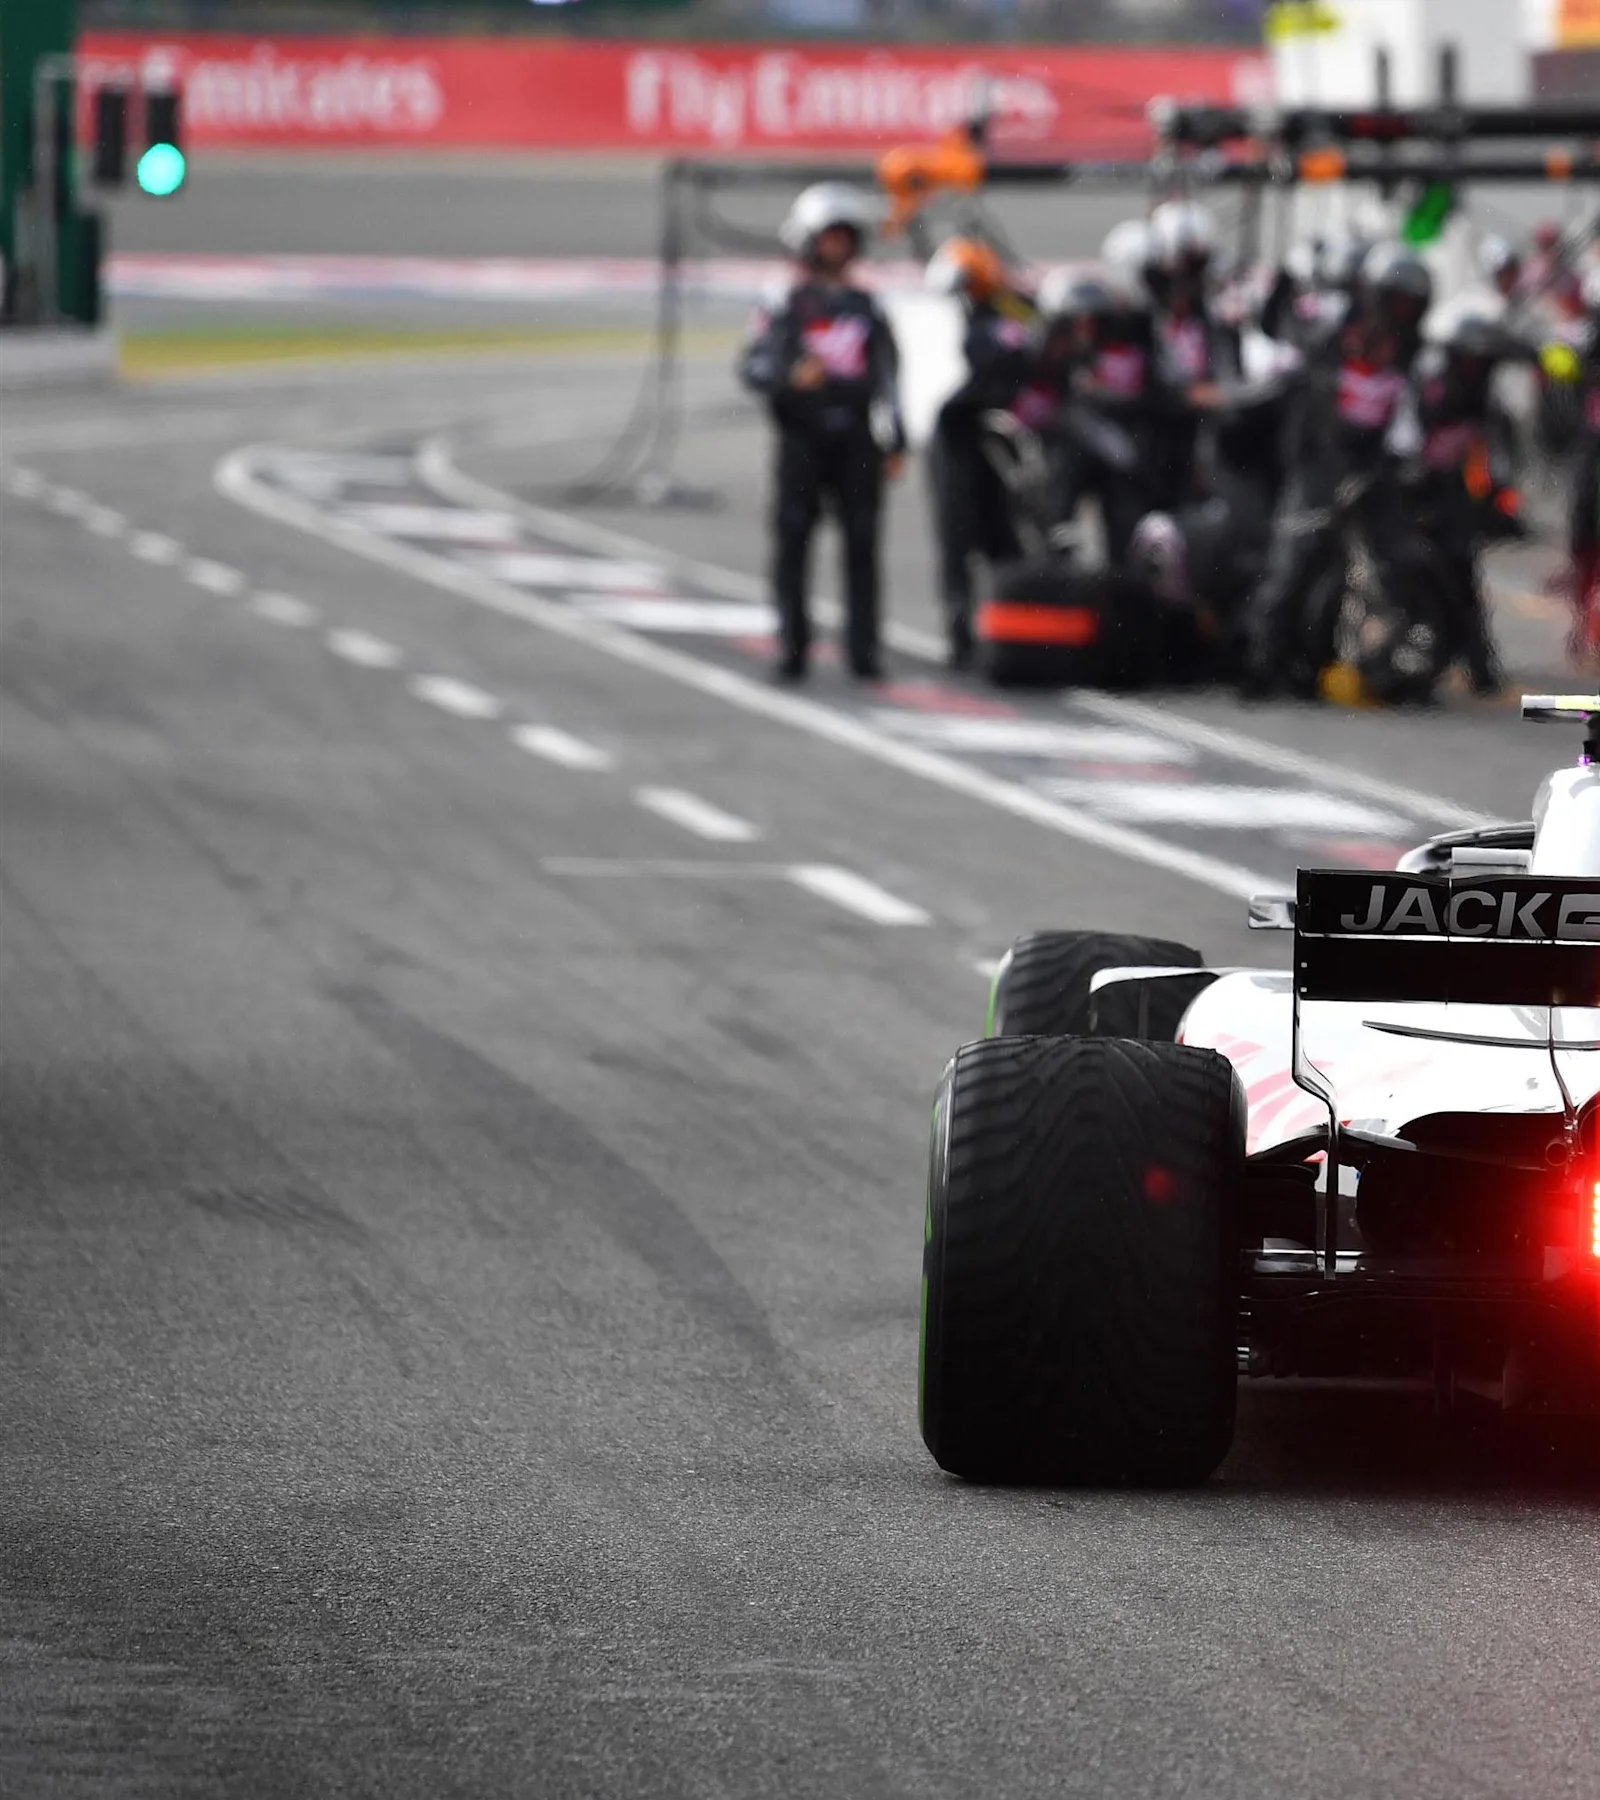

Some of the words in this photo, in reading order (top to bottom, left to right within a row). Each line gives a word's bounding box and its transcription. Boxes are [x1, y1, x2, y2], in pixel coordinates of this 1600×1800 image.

[628, 50, 744, 149] Fly
[754, 50, 1057, 137] Emirates
[1340, 885, 1552, 937] JACK
